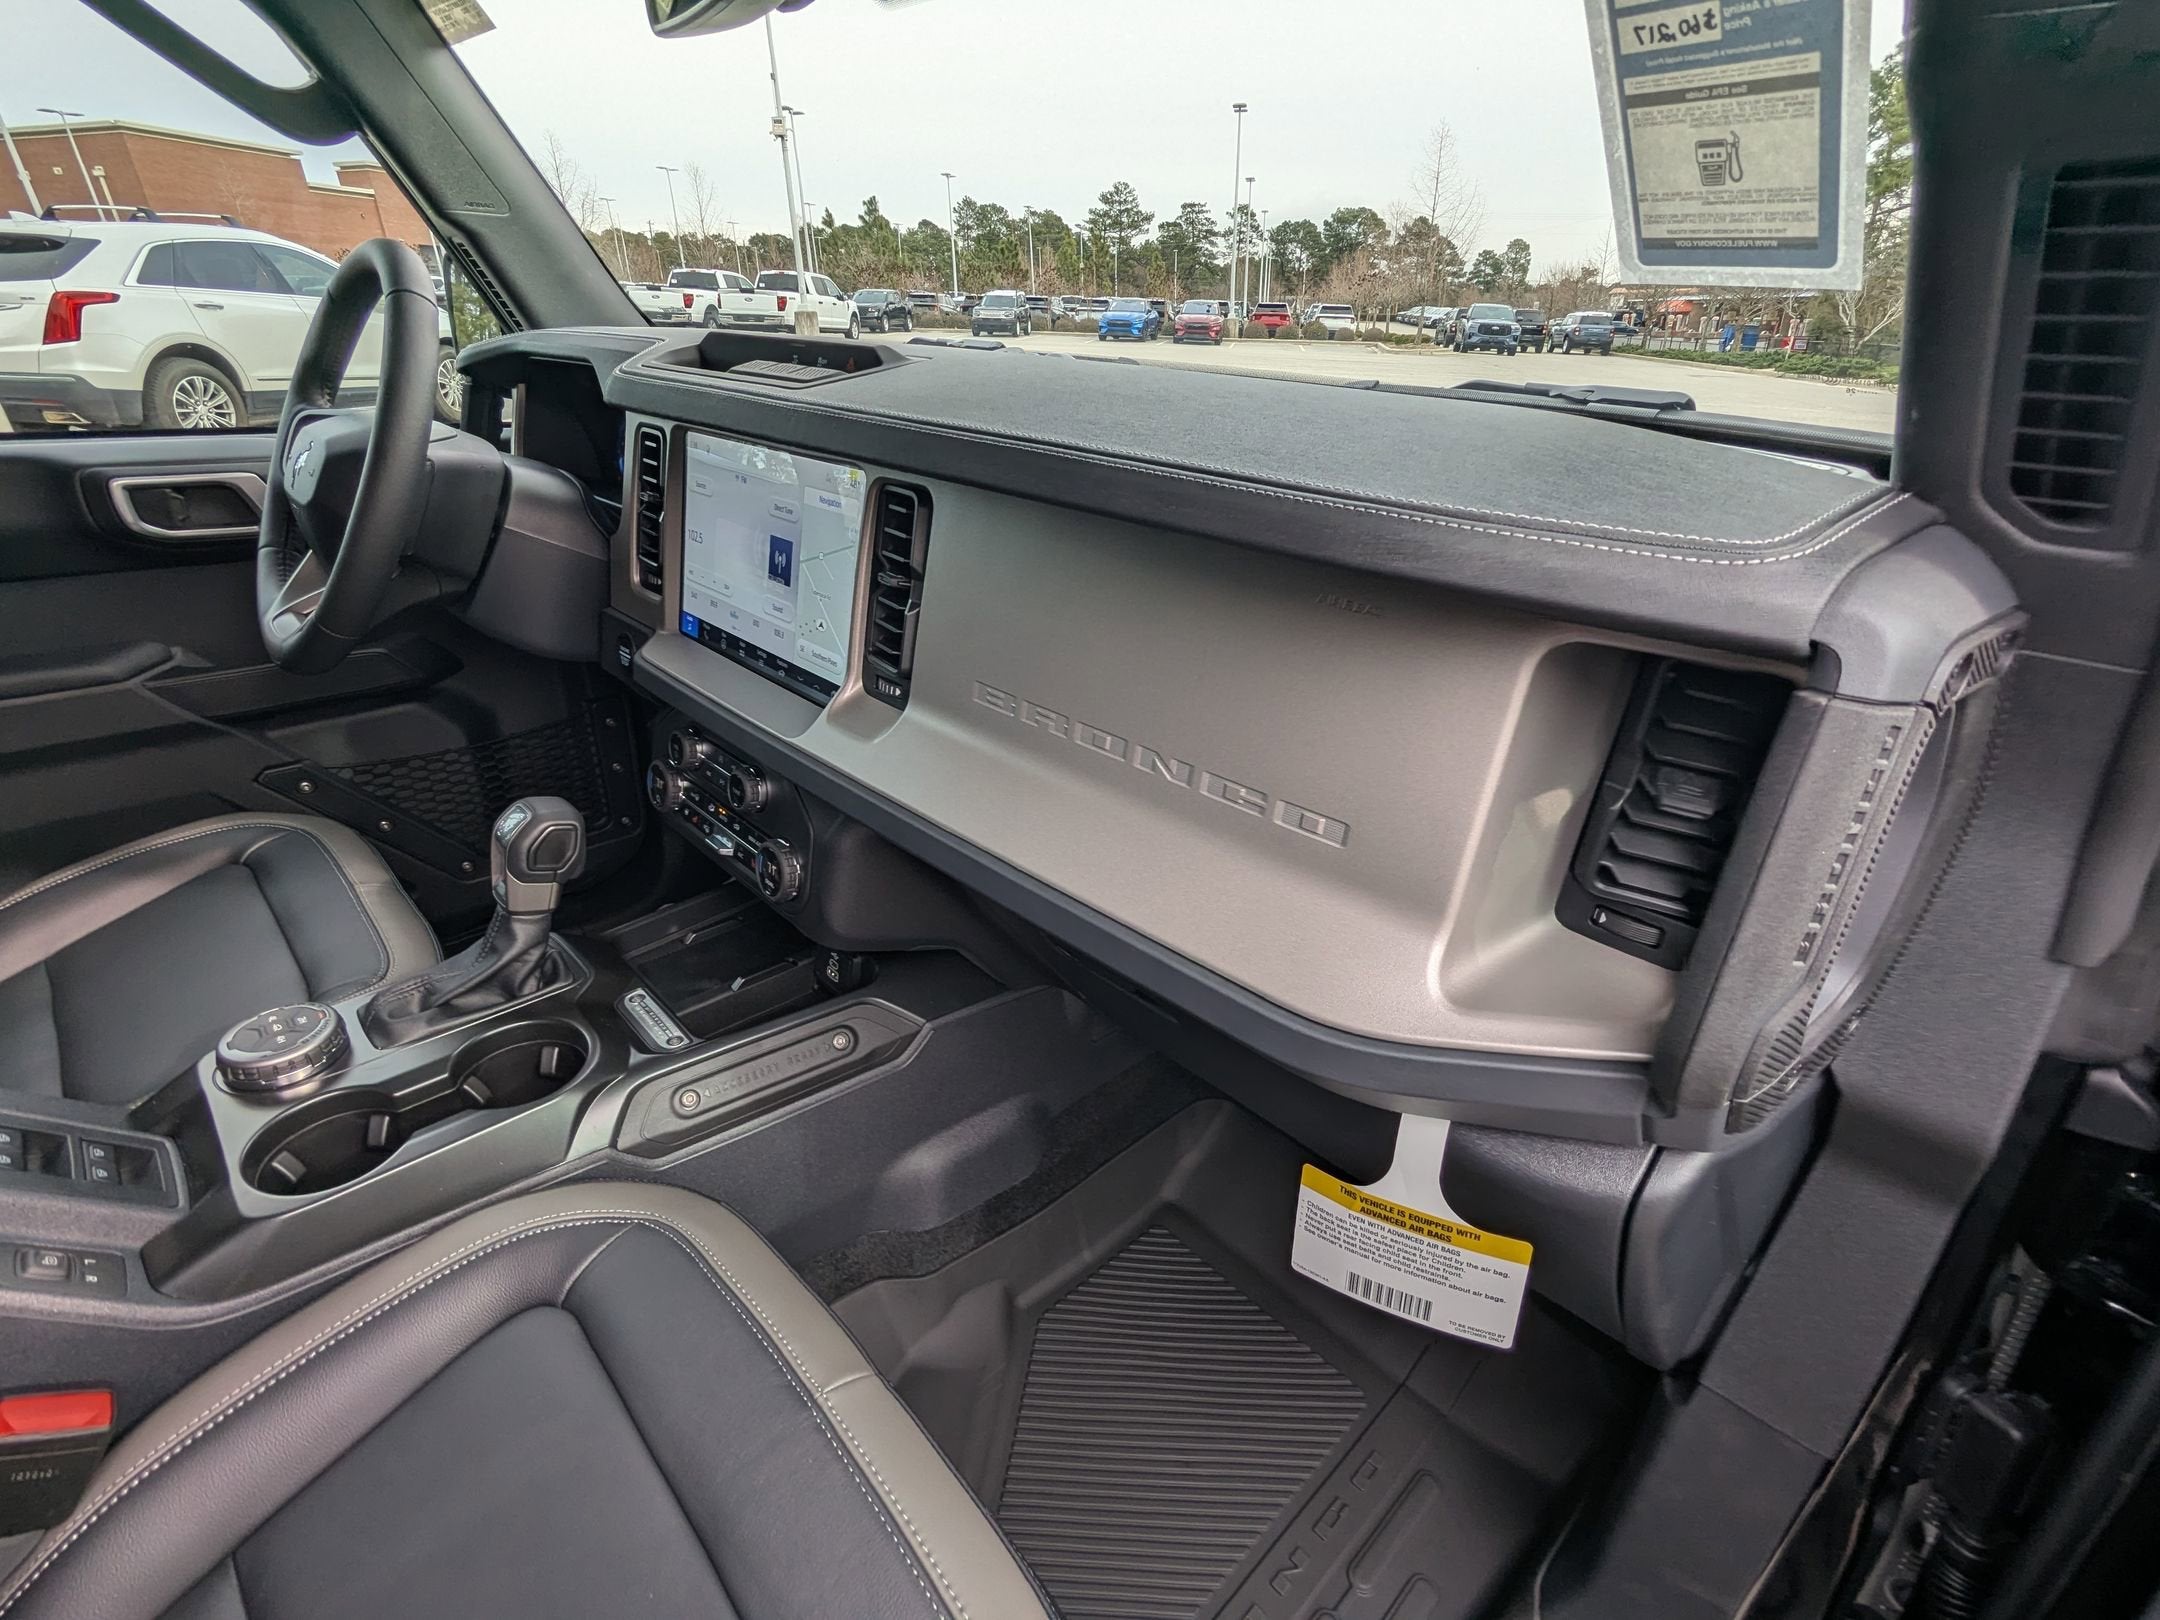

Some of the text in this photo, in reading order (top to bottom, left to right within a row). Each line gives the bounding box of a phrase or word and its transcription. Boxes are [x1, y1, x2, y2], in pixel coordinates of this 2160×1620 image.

[818, 495, 842, 509] Navigation
[687, 528, 704, 545] 102.5
[972, 679, 1353, 850] BRONCO
[1306, 1207, 1318, 1216] The
[1320, 1214, 1334, 1225] back
[1337, 1224, 1351, 1234] seat
[1360, 1233, 1371, 1241] the
[1374, 1237, 1396, 1249] safest
[1397, 1246, 1417, 1257] place
[1432, 1259, 1466, 1273] Children.
[1307, 1200, 1334, 1218] Children
[1335, 1216, 1348, 1225] can
[1349, 1221, 1357, 1229] be
[1360, 1224, 1378, 1237] killed
[1390, 1237, 1424, 1253] seriously
[1426, 1250, 1453, 1262] injured
[1455, 1258, 1464, 1266] by
[1466, 1262, 1478, 1270] the
[1493, 1269, 1510, 1279] bag.
[1340, 1185, 1357, 1200] THIS
[1360, 1196, 1394, 1214] VEHICLE
[1409, 1214, 1453, 1233] EQUIPPED
[1456, 1228, 1481, 1241] WITH
[1348, 1213, 1461, 1256] EVEN WITH ADVANCED AIR BAGS
[1360, 1206, 1452, 1242] ADVANCED AIR BAGS
[1303, 1225, 1316, 1236] See
[1317, 1233, 1342, 1248] owner's
[1344, 1246, 1370, 1260] manual
[1371, 1256, 1382, 1264] for
[1383, 1262, 1402, 1271] more
[1404, 1268, 1446, 1287] information
[1448, 1284, 1470, 1294] about
[1484, 1293, 1506, 1303] bags.
[1305, 1213, 1324, 1226] Never
[1325, 1224, 1336, 1232] put
[1344, 1233, 1357, 1241] rear
[1359, 1239, 1380, 1251] facing
[1382, 1248, 1400, 1258] child
[1402, 1255, 1417, 1263] seat
[1429, 1264, 1441, 1272] the
[1443, 1268, 1463, 1279] front.
[1305, 1220, 1451, 1281] Always use seat belts and child restraints.
